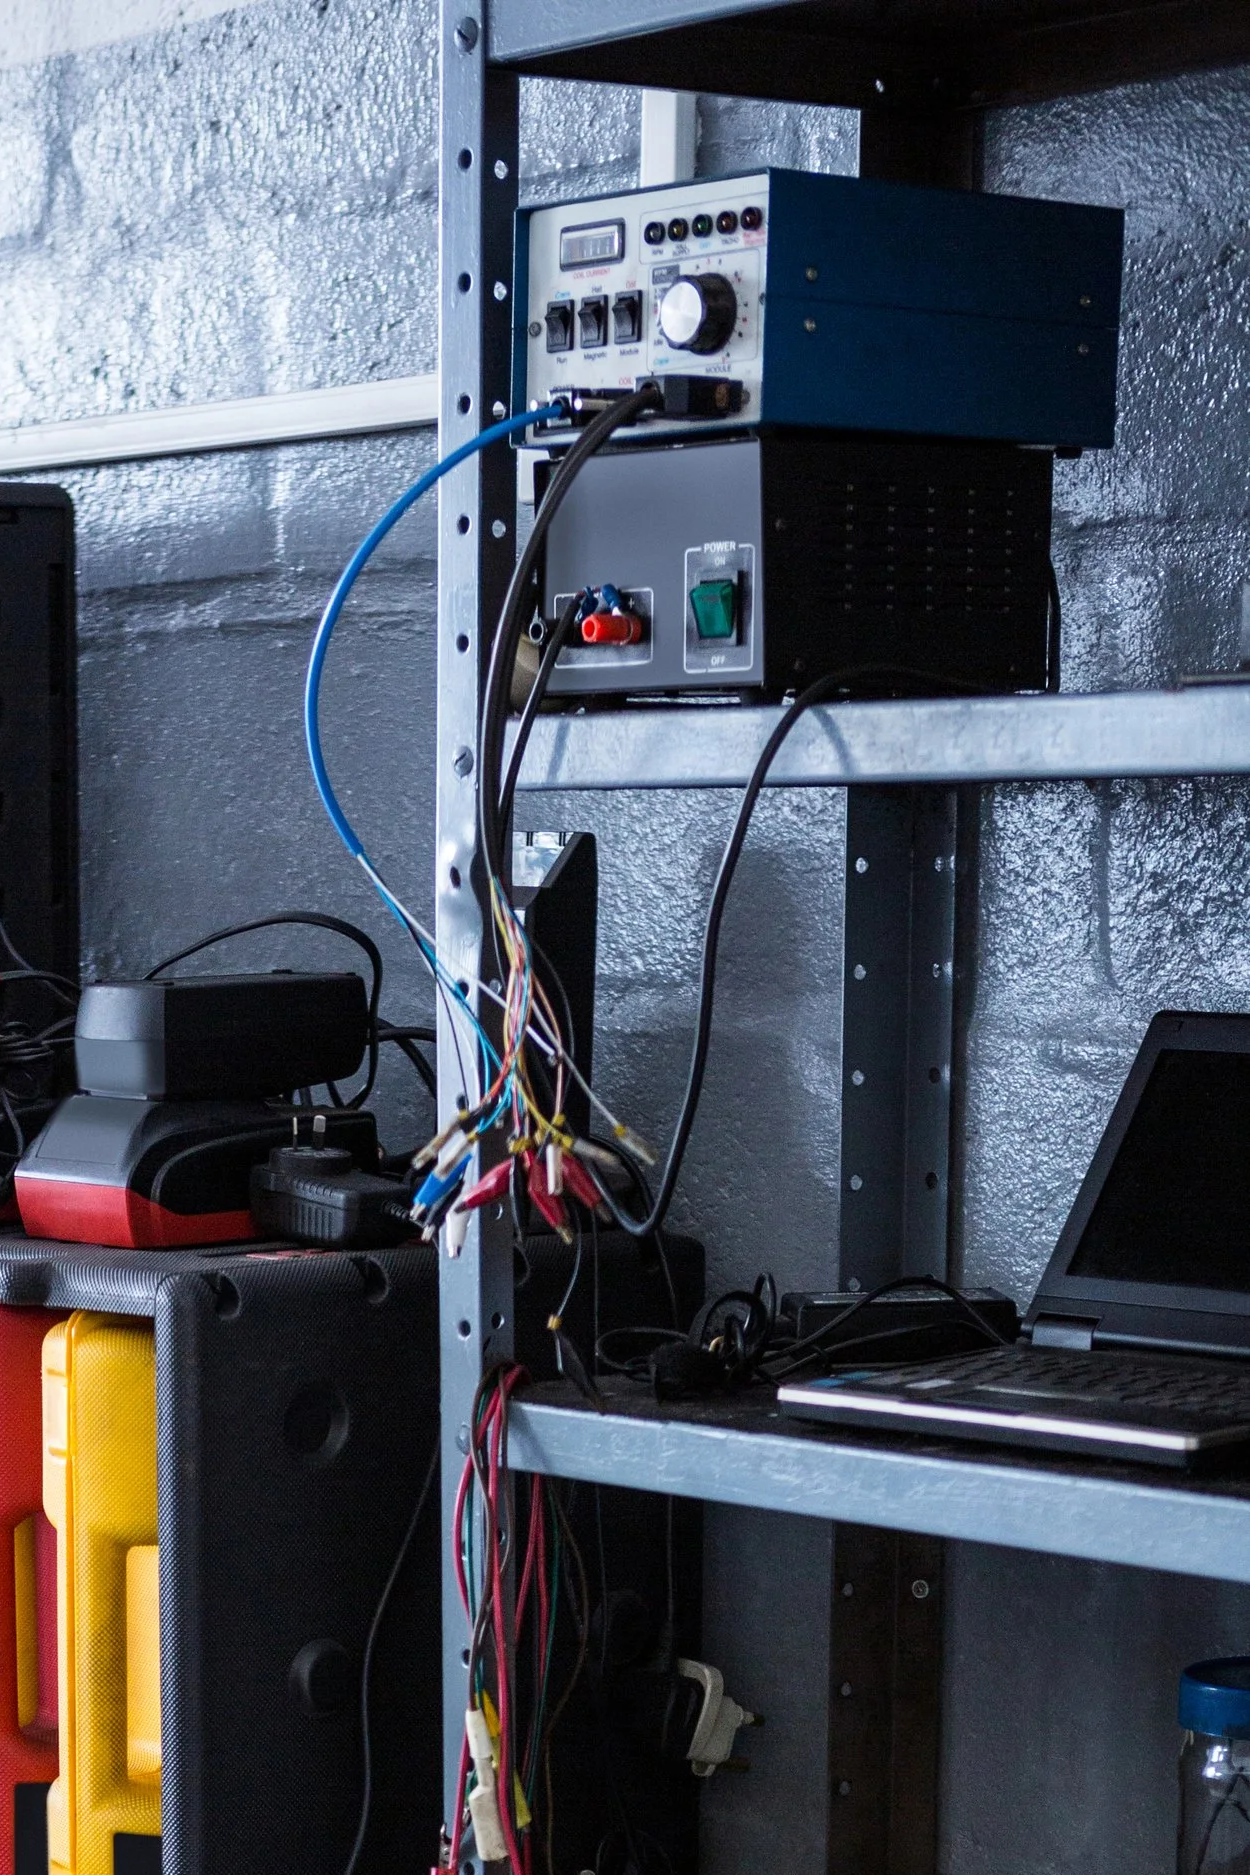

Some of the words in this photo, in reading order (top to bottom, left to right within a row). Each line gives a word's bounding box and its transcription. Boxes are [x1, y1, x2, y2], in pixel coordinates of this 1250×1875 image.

[556, 356, 568, 365] Run
[703, 541, 736, 553] POWER
[714, 556, 726, 566] ON
[711, 656, 725, 666] OFF
